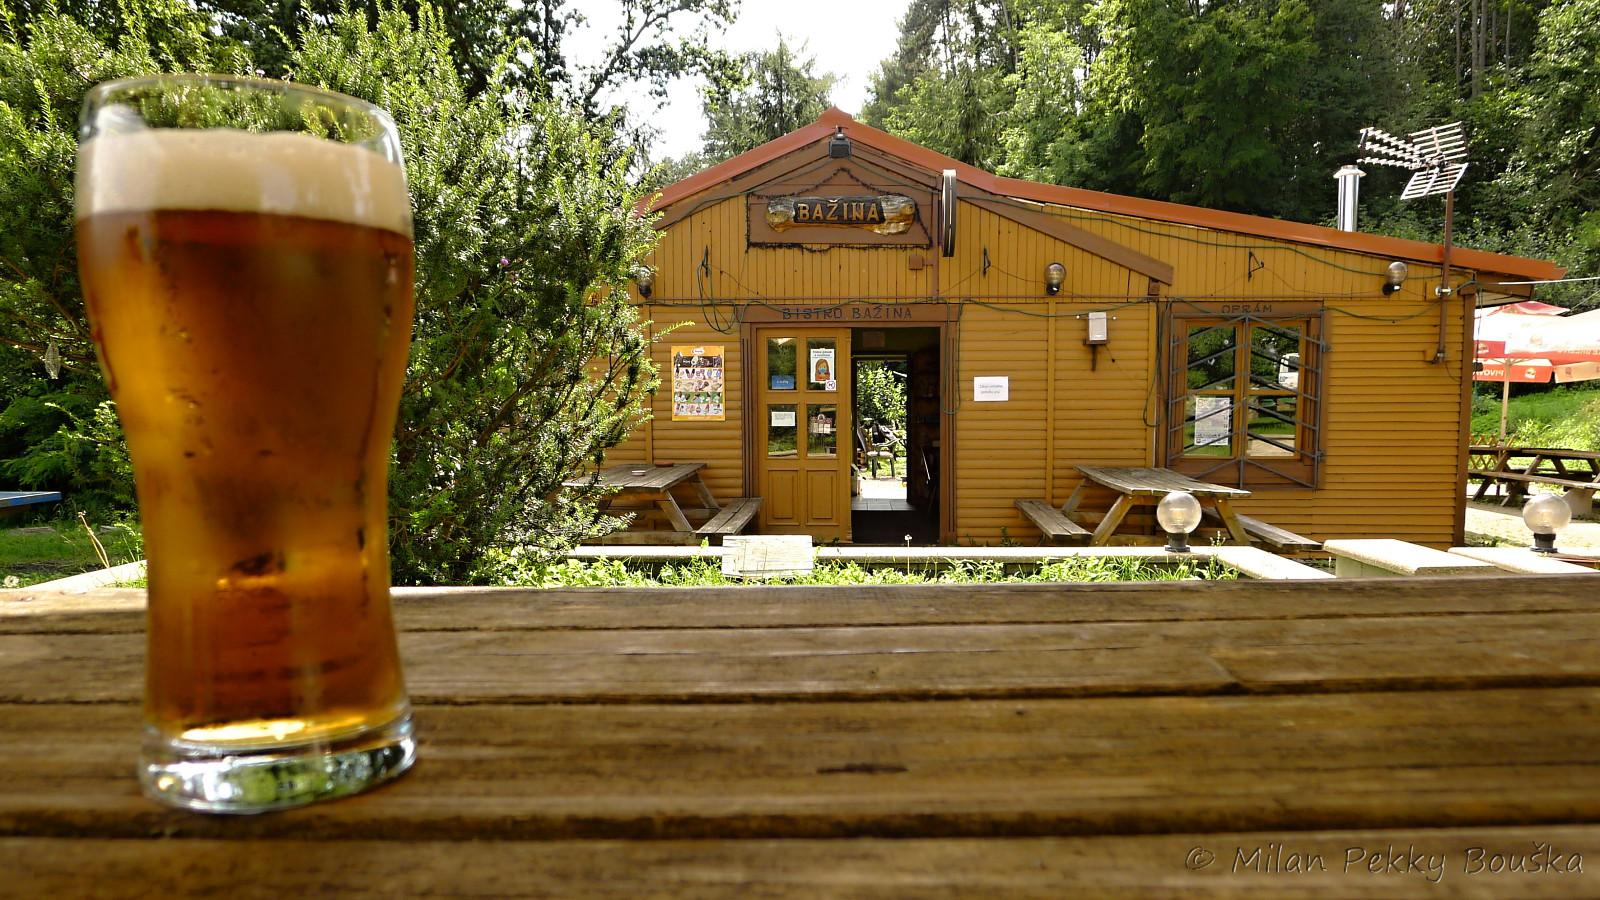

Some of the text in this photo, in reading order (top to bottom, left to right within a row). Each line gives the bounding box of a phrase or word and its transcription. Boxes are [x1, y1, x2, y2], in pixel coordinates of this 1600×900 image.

[797, 199, 880, 221] BAŽINA
[783, 304, 913, 320] BISTRO BAŽINA
